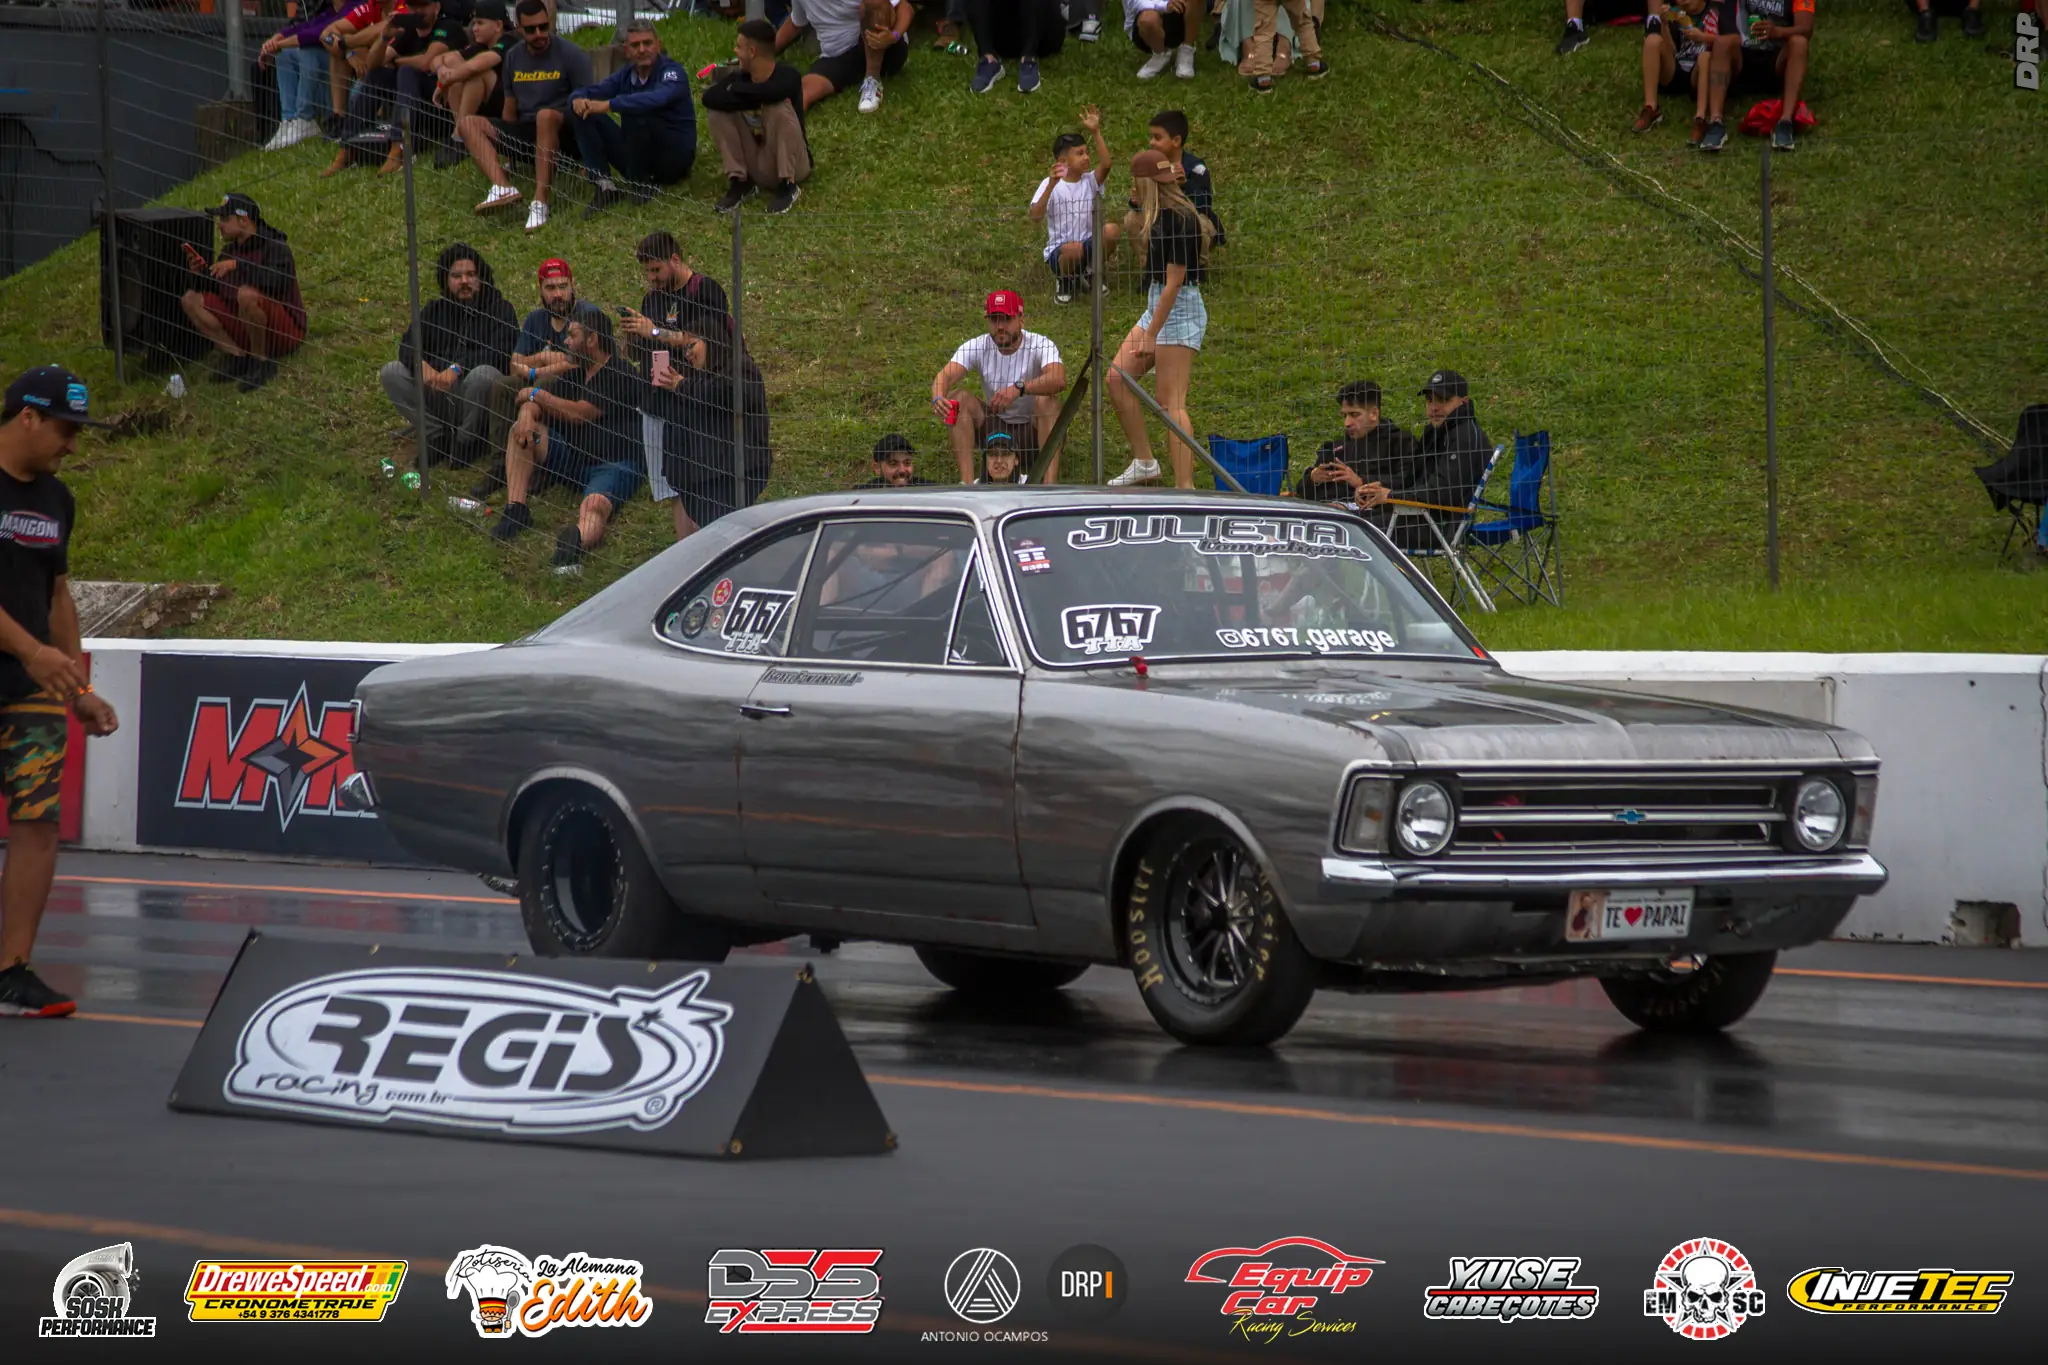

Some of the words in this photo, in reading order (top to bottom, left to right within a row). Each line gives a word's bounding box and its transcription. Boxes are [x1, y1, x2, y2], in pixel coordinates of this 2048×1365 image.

[0, 514, 60, 538] MANGONI
[1067, 515, 1350, 550] JULIETA
[723, 590, 794, 641] 6767
[1063, 605, 1158, 647] 6767
[1606, 907, 1622, 928] TE
[1643, 904, 1687, 928] PAPAI
